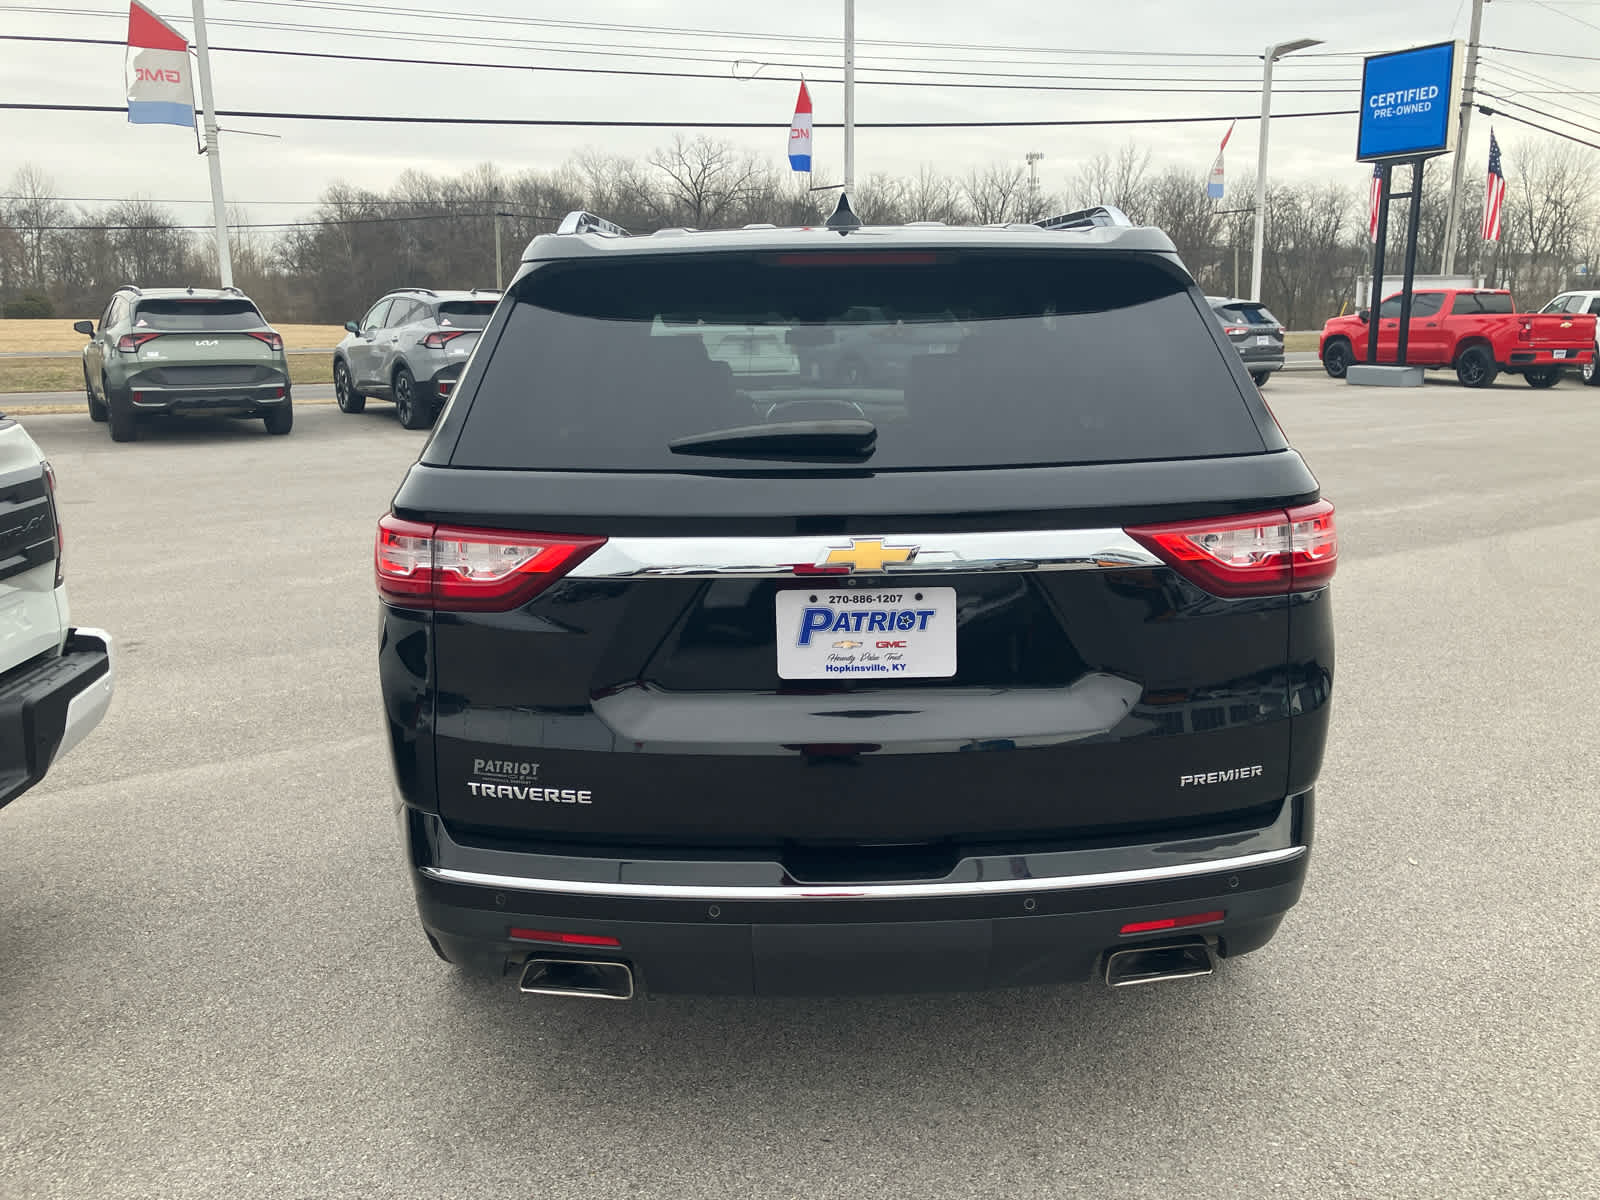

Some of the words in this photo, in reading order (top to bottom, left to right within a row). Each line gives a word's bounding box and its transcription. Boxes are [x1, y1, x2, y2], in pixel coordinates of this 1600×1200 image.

[1369, 85, 1439, 108] CERTIFIED
[1373, 101, 1432, 119] PRE-OWNED
[828, 594, 904, 604] 270-886-1207
[797, 606, 936, 647] PATRIOT
[876, 641, 907, 649] GMC
[825, 664, 889, 674] Hopkinsville,
[892, 663, 907, 671] KY
[473, 759, 540, 776] PATRIOT
[1180, 765, 1263, 787] PREMIER
[467, 782, 593, 804] TRAVERSE
